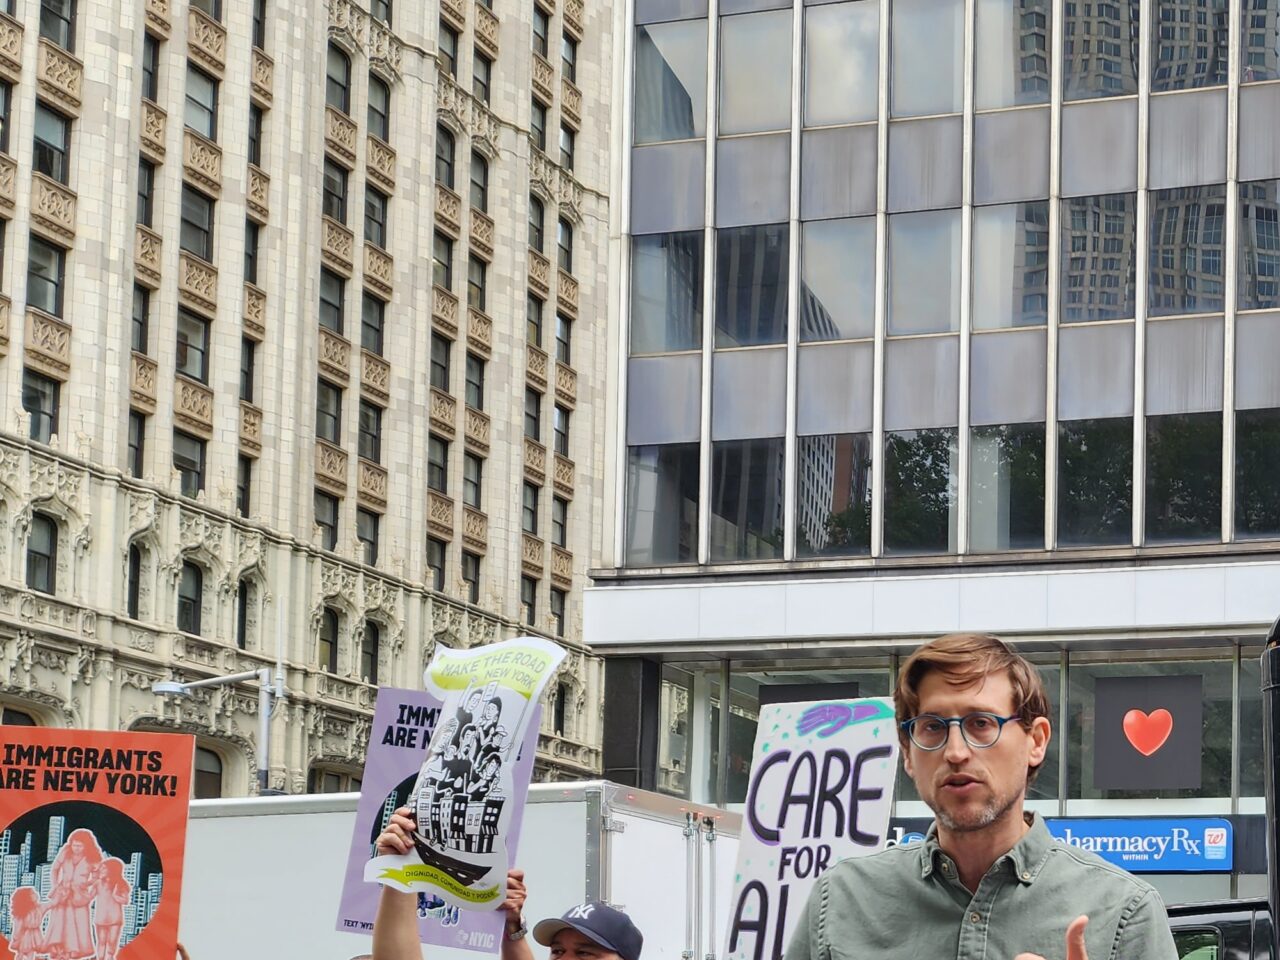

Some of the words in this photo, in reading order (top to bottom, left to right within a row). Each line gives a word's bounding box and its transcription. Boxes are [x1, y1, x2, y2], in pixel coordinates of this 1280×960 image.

[441, 660, 480, 677] MAKE
[484, 667, 511, 679] NEW
[511, 669, 535, 689] YORK
[396, 703, 442, 728] IMM
[381, 725, 418, 749] ARE
[3, 744, 163, 772] IMMIGRANTS
[43, 770, 99, 793] NEW
[105, 773, 177, 797] YORK!
[747, 745, 892, 847] CARE
[778, 844, 832, 881] FOR
[343, 919, 358, 928] TEXT
[468, 931, 495, 948] NYIC
